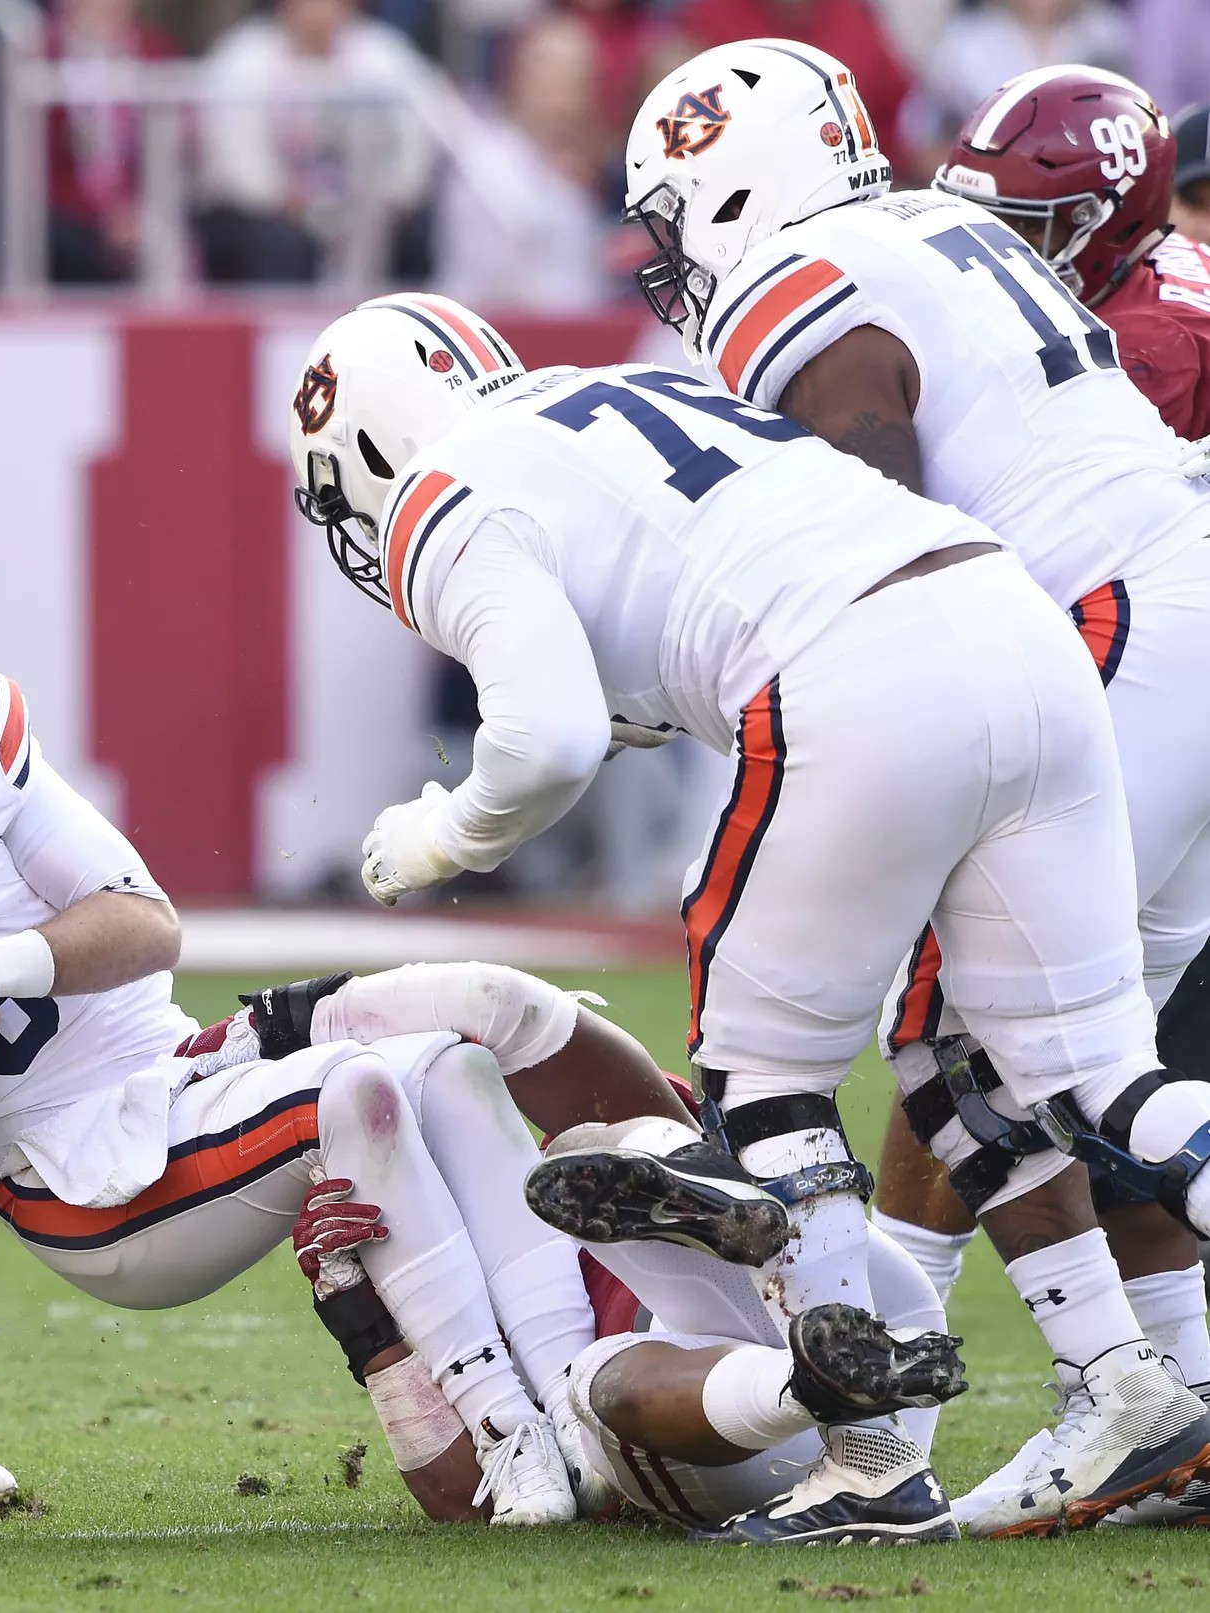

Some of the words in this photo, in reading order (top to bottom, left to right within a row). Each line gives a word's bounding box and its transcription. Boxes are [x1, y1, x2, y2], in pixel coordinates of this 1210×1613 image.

[833, 149, 847, 165] 77
[1089, 114, 1148, 181] 99
[848, 168, 878, 191] WAR
[921, 222, 1120, 388] 77
[445, 374, 463, 391] 76
[476, 379, 501, 398] WAR
